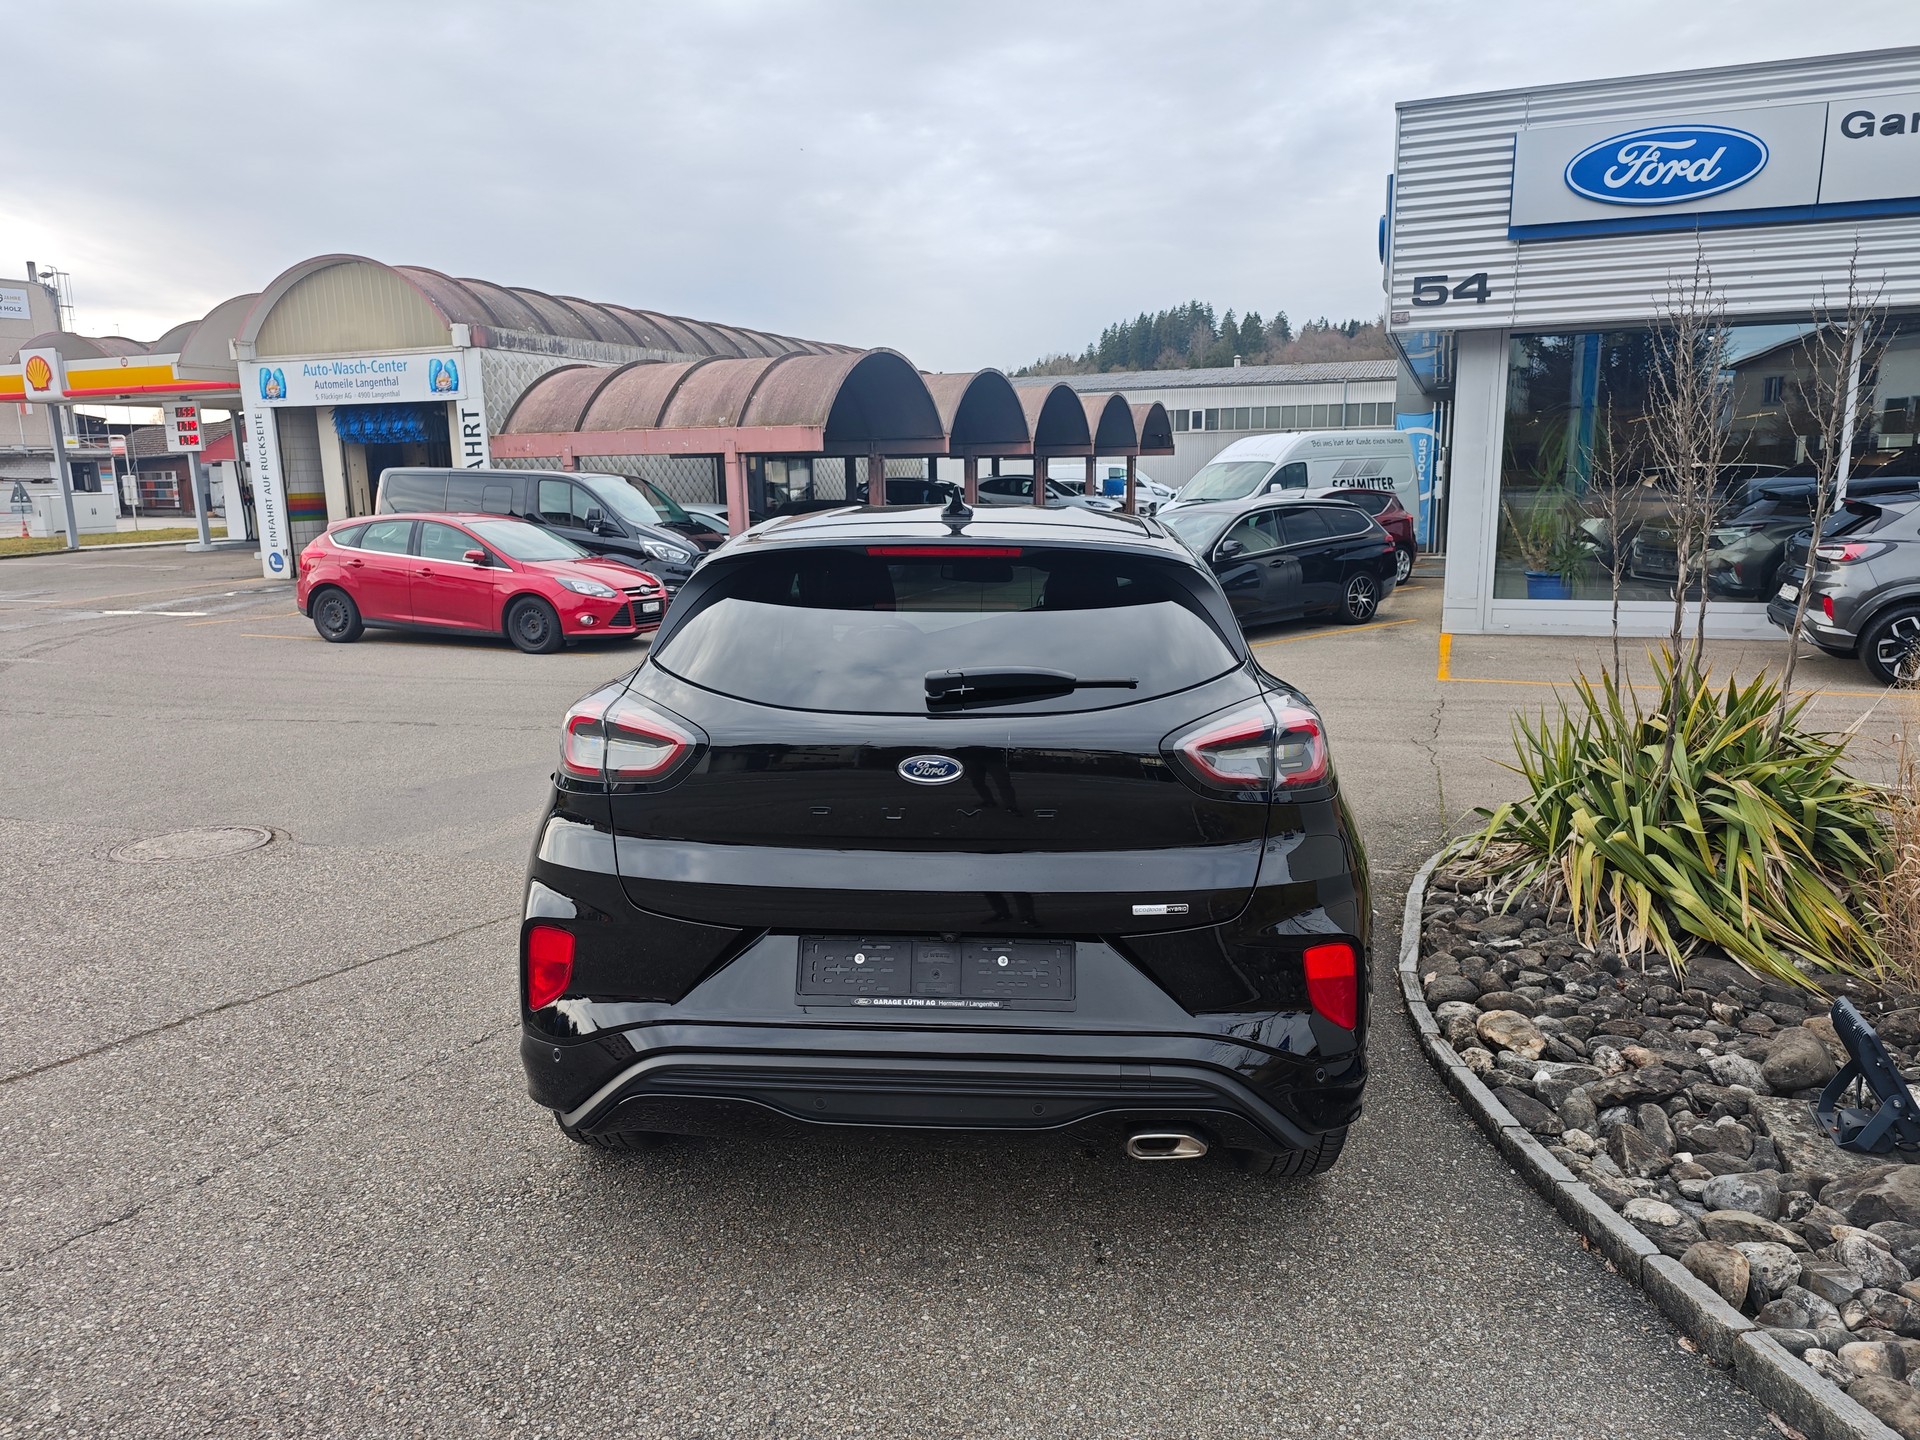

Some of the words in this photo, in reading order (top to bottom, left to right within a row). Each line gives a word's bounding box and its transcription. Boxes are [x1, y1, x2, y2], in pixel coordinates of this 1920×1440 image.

[1603, 139, 1727, 189] Ford
[1411, 272, 1492, 307] 54
[303, 360, 408, 376] Auto-Wasch-Center
[314, 378, 353, 390] Automeile
[355, 376, 399, 390] Langenthal
[371, 390, 400, 400] Langenthal
[254, 413, 269, 471] RÜCKSEITE
[1345, 437, 1355, 446] der
[262, 475, 271, 495] AUF
[1332, 477, 1396, 491] SCHMITTER
[264, 498, 279, 548] EINFAHRT
[913, 760, 949, 776] Ford
[903, 998, 925, 1006] LÜTHI
[969, 1000, 1000, 1008] Langenthal
